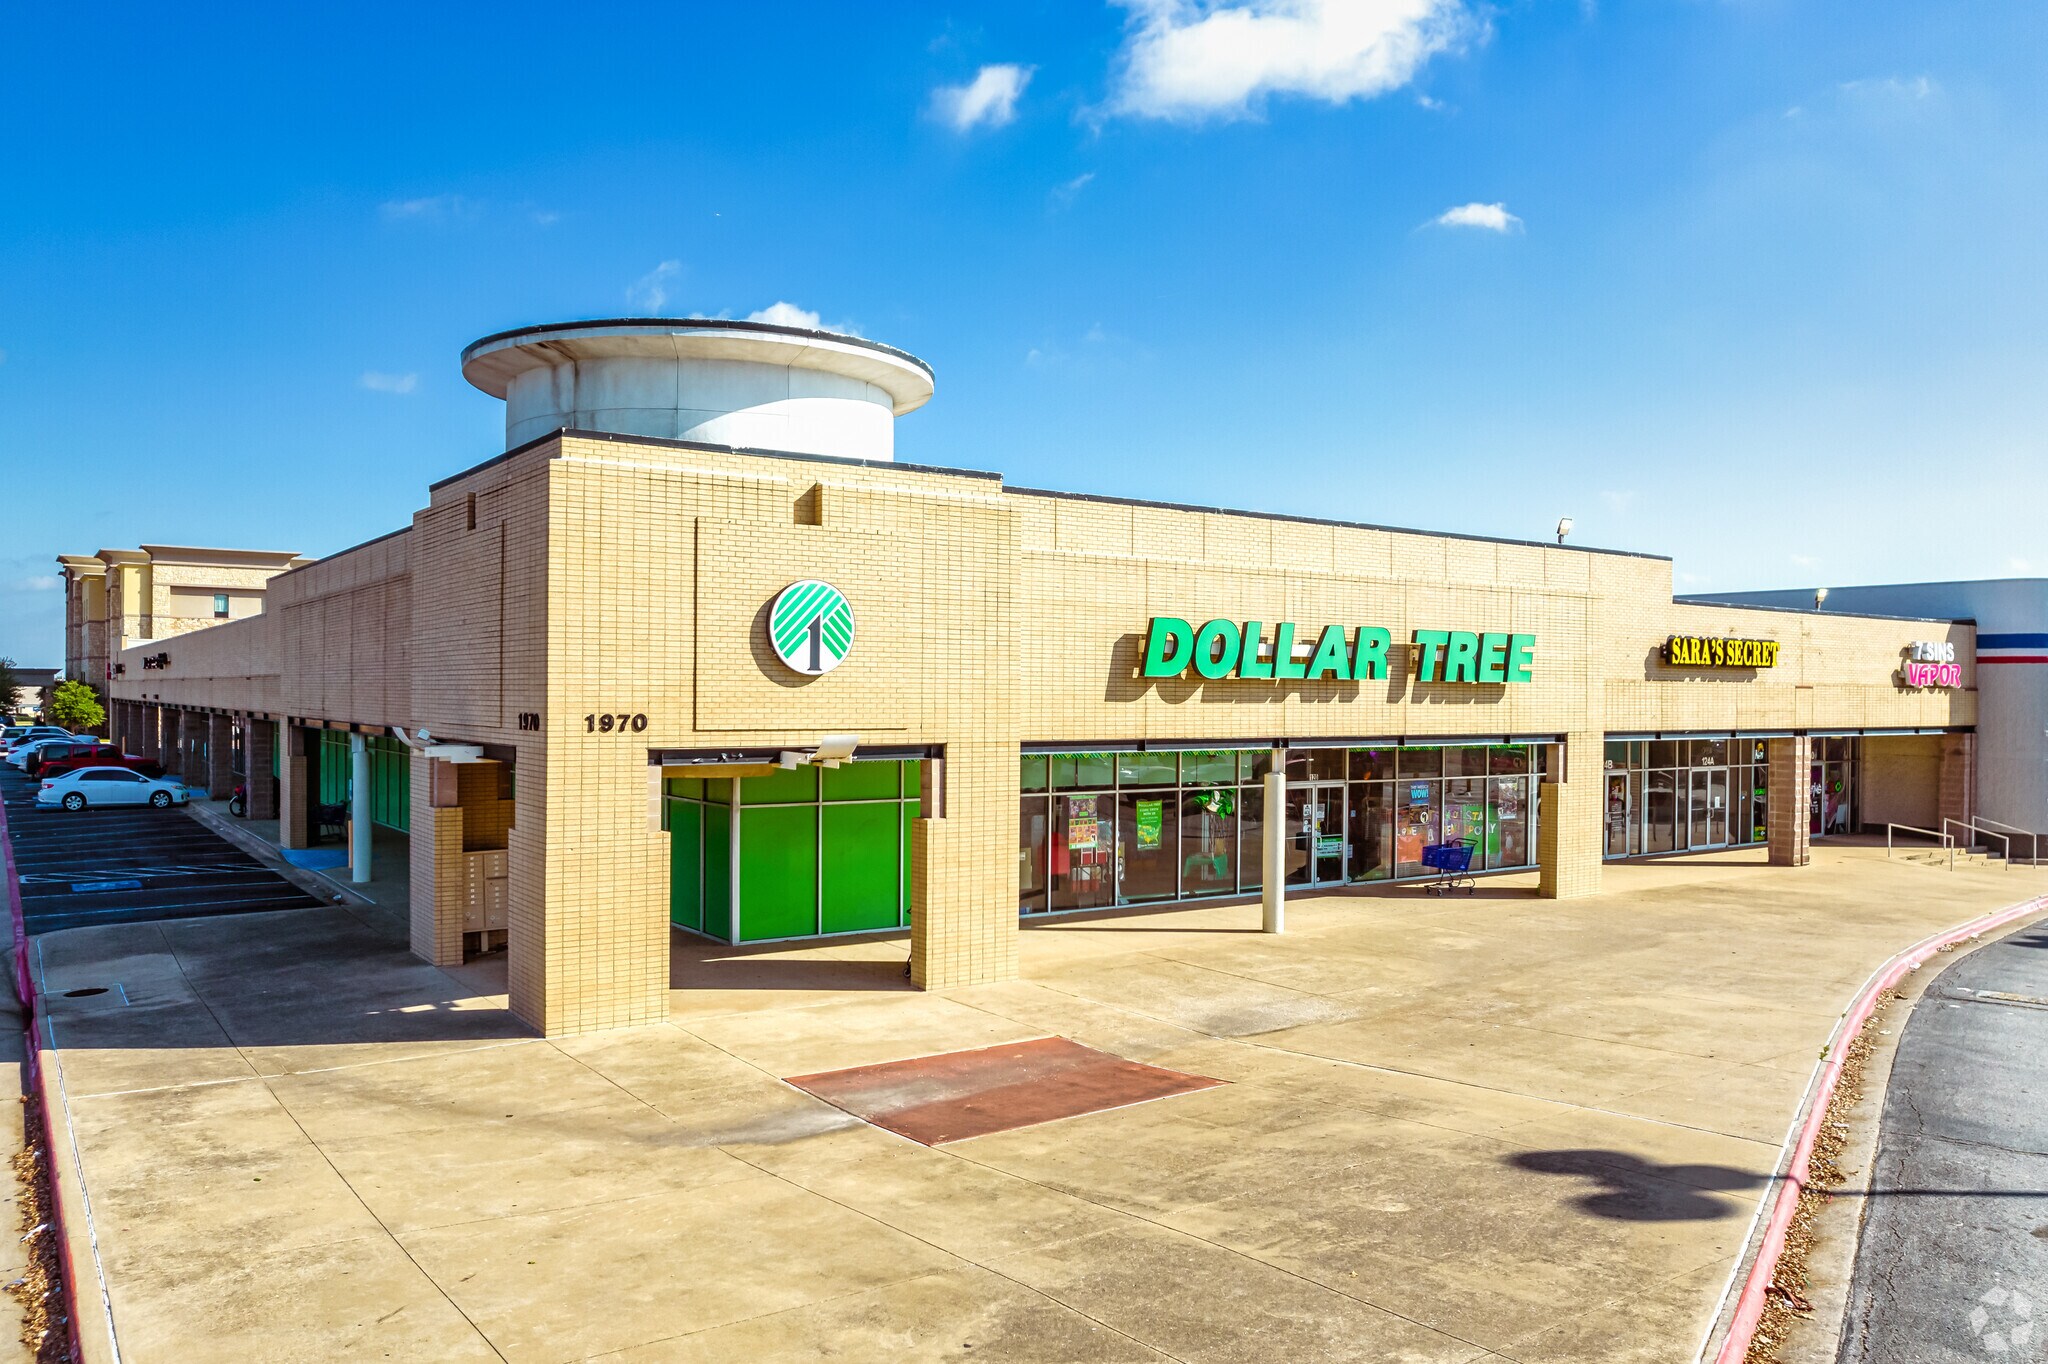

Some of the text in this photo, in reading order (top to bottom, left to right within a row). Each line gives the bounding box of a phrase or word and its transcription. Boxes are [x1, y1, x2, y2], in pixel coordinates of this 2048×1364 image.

[1143, 617, 1537, 683] DOLLAR TREE
[1672, 638, 1780, 667] SARA'S SECRET
[1915, 641, 1955, 662] 7 SINS
[1907, 663, 1962, 688] VAPOR
[518, 712, 540, 731] 1970
[584, 713, 648, 733] 1970
[1701, 756, 1715, 766] 124A
[1411, 789, 1429, 799] WOW!
